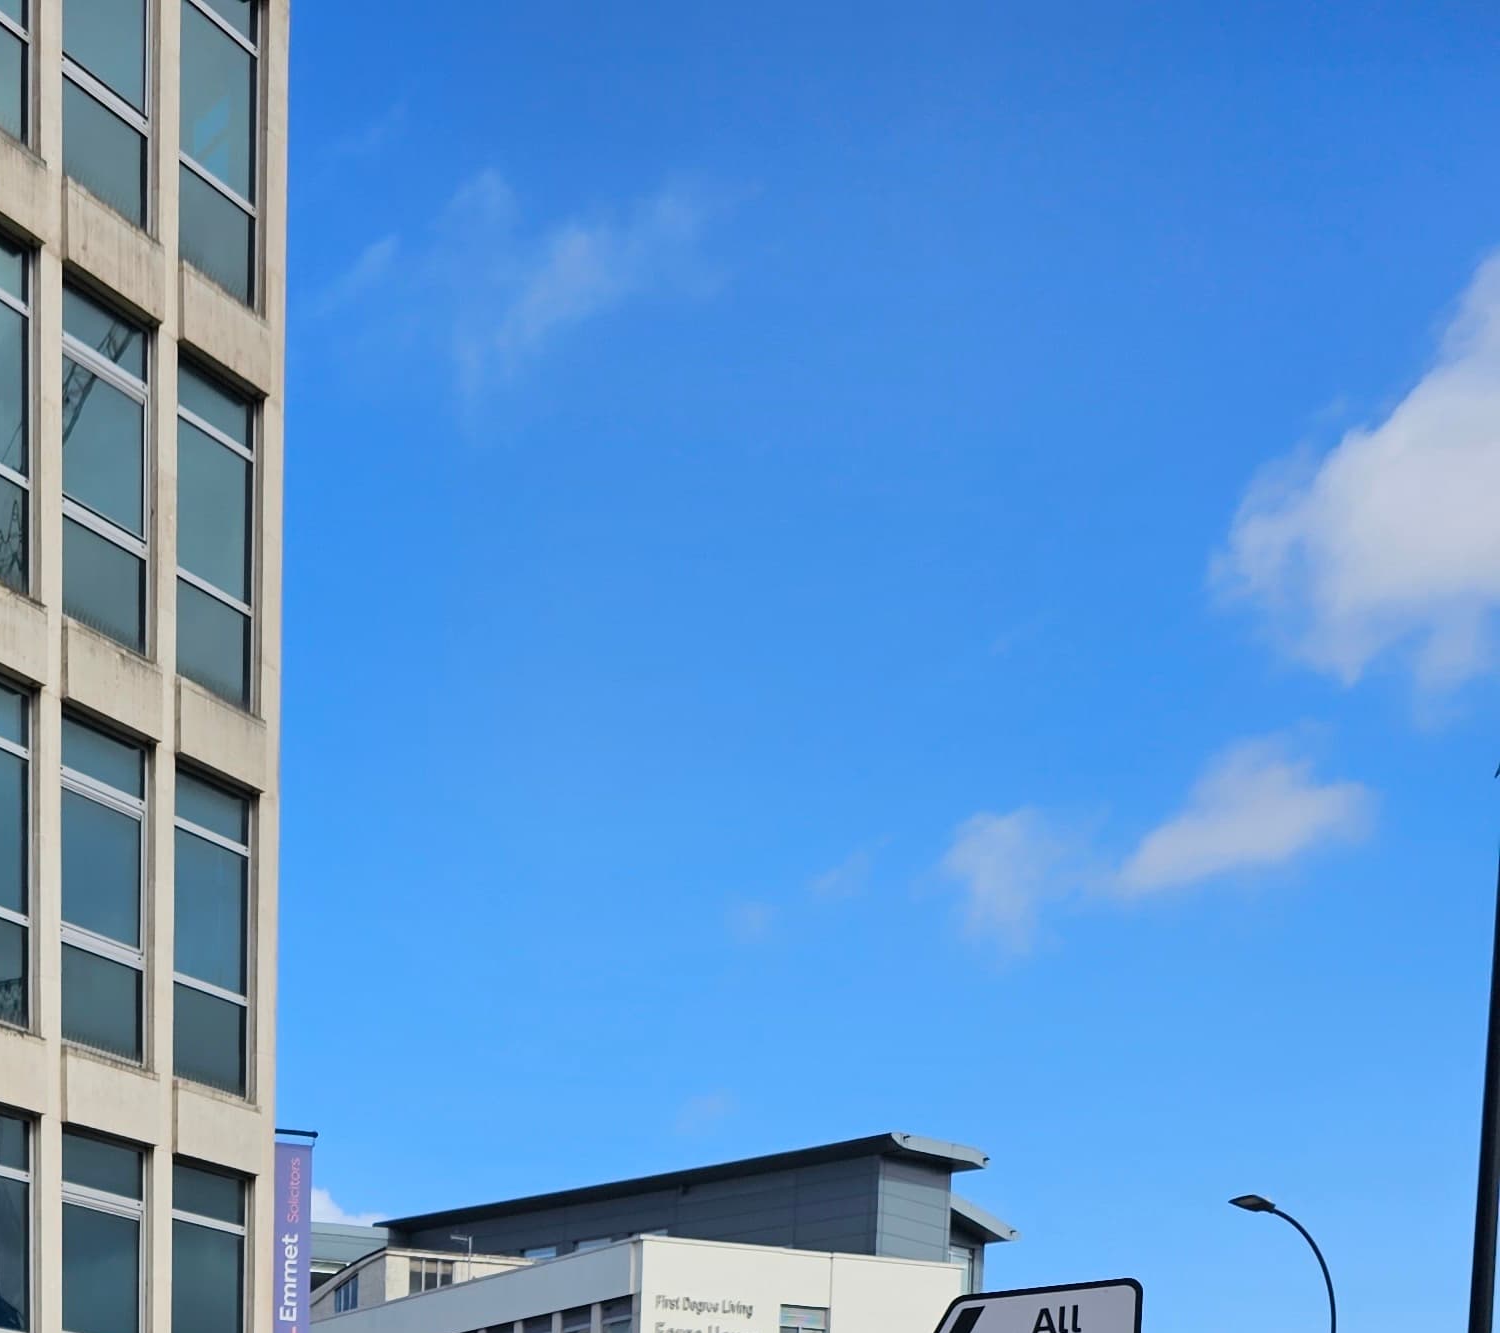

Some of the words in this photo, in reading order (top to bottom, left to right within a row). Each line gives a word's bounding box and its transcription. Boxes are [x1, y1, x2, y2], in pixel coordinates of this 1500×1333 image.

[287, 1157, 300, 1224] Solicitors
[279, 1233, 299, 1322] Emmet
[655, 1295, 679, 1310] First
[682, 1297, 719, 1316] Degree
[722, 1300, 754, 1319] Living
